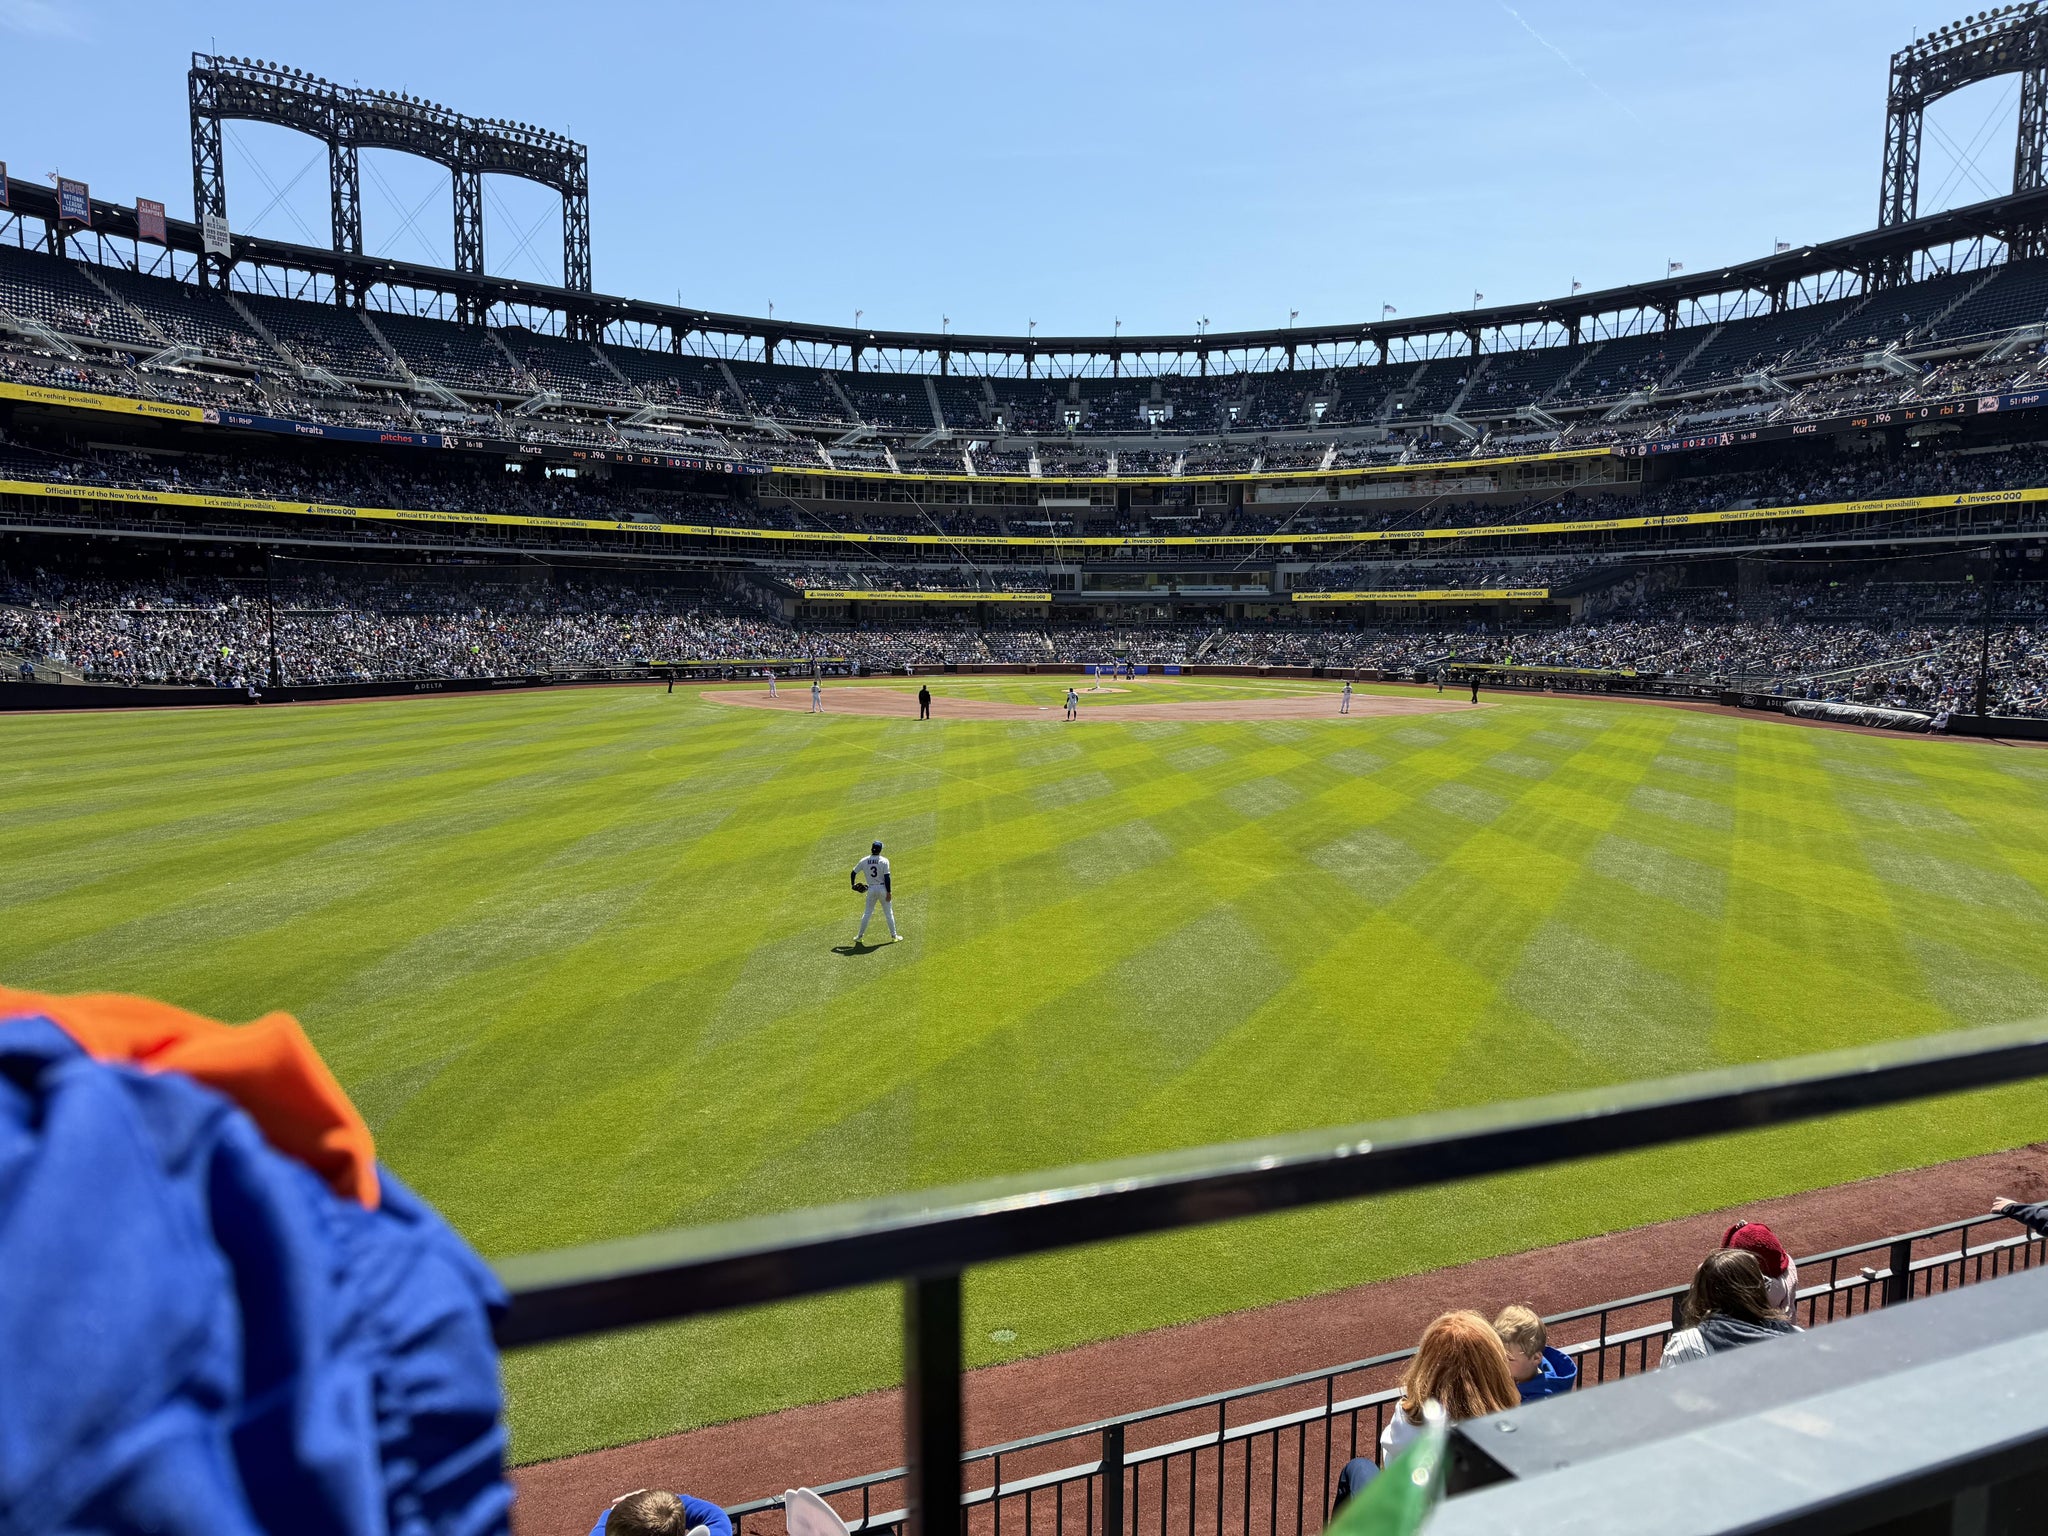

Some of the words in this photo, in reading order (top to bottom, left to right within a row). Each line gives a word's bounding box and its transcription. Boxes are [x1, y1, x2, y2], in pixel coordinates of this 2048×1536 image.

[63, 181, 84, 195] 2015
[44, 392, 67, 400] rethink
[148, 404, 174, 414] Invesco
[176, 408, 190, 416] QQQ
[1852, 417, 1867, 427] avg
[1872, 413, 1891, 424] .196
[1906, 410, 1915, 419] hr
[1921, 408, 1928, 418] 0
[1940, 406, 1953, 415] rbi
[1958, 404, 1964, 413] 2
[296, 424, 323, 435] Peralta
[1793, 424, 1816, 434] Kurtz
[380, 433, 412, 443] pitches
[519, 445, 542, 454] Kurtz
[1661, 444, 1671, 452] Top
[573, 451, 586, 459] avg
[45, 487, 72, 495] Official
[1968, 494, 2001, 502] Invesco
[2003, 492, 2022, 501] QQQ
[220, 500, 242, 508] rethink
[1862, 502, 1883, 510] rethink
[317, 506, 342, 514] Invesco
[871, 866, 877, 877] 3
